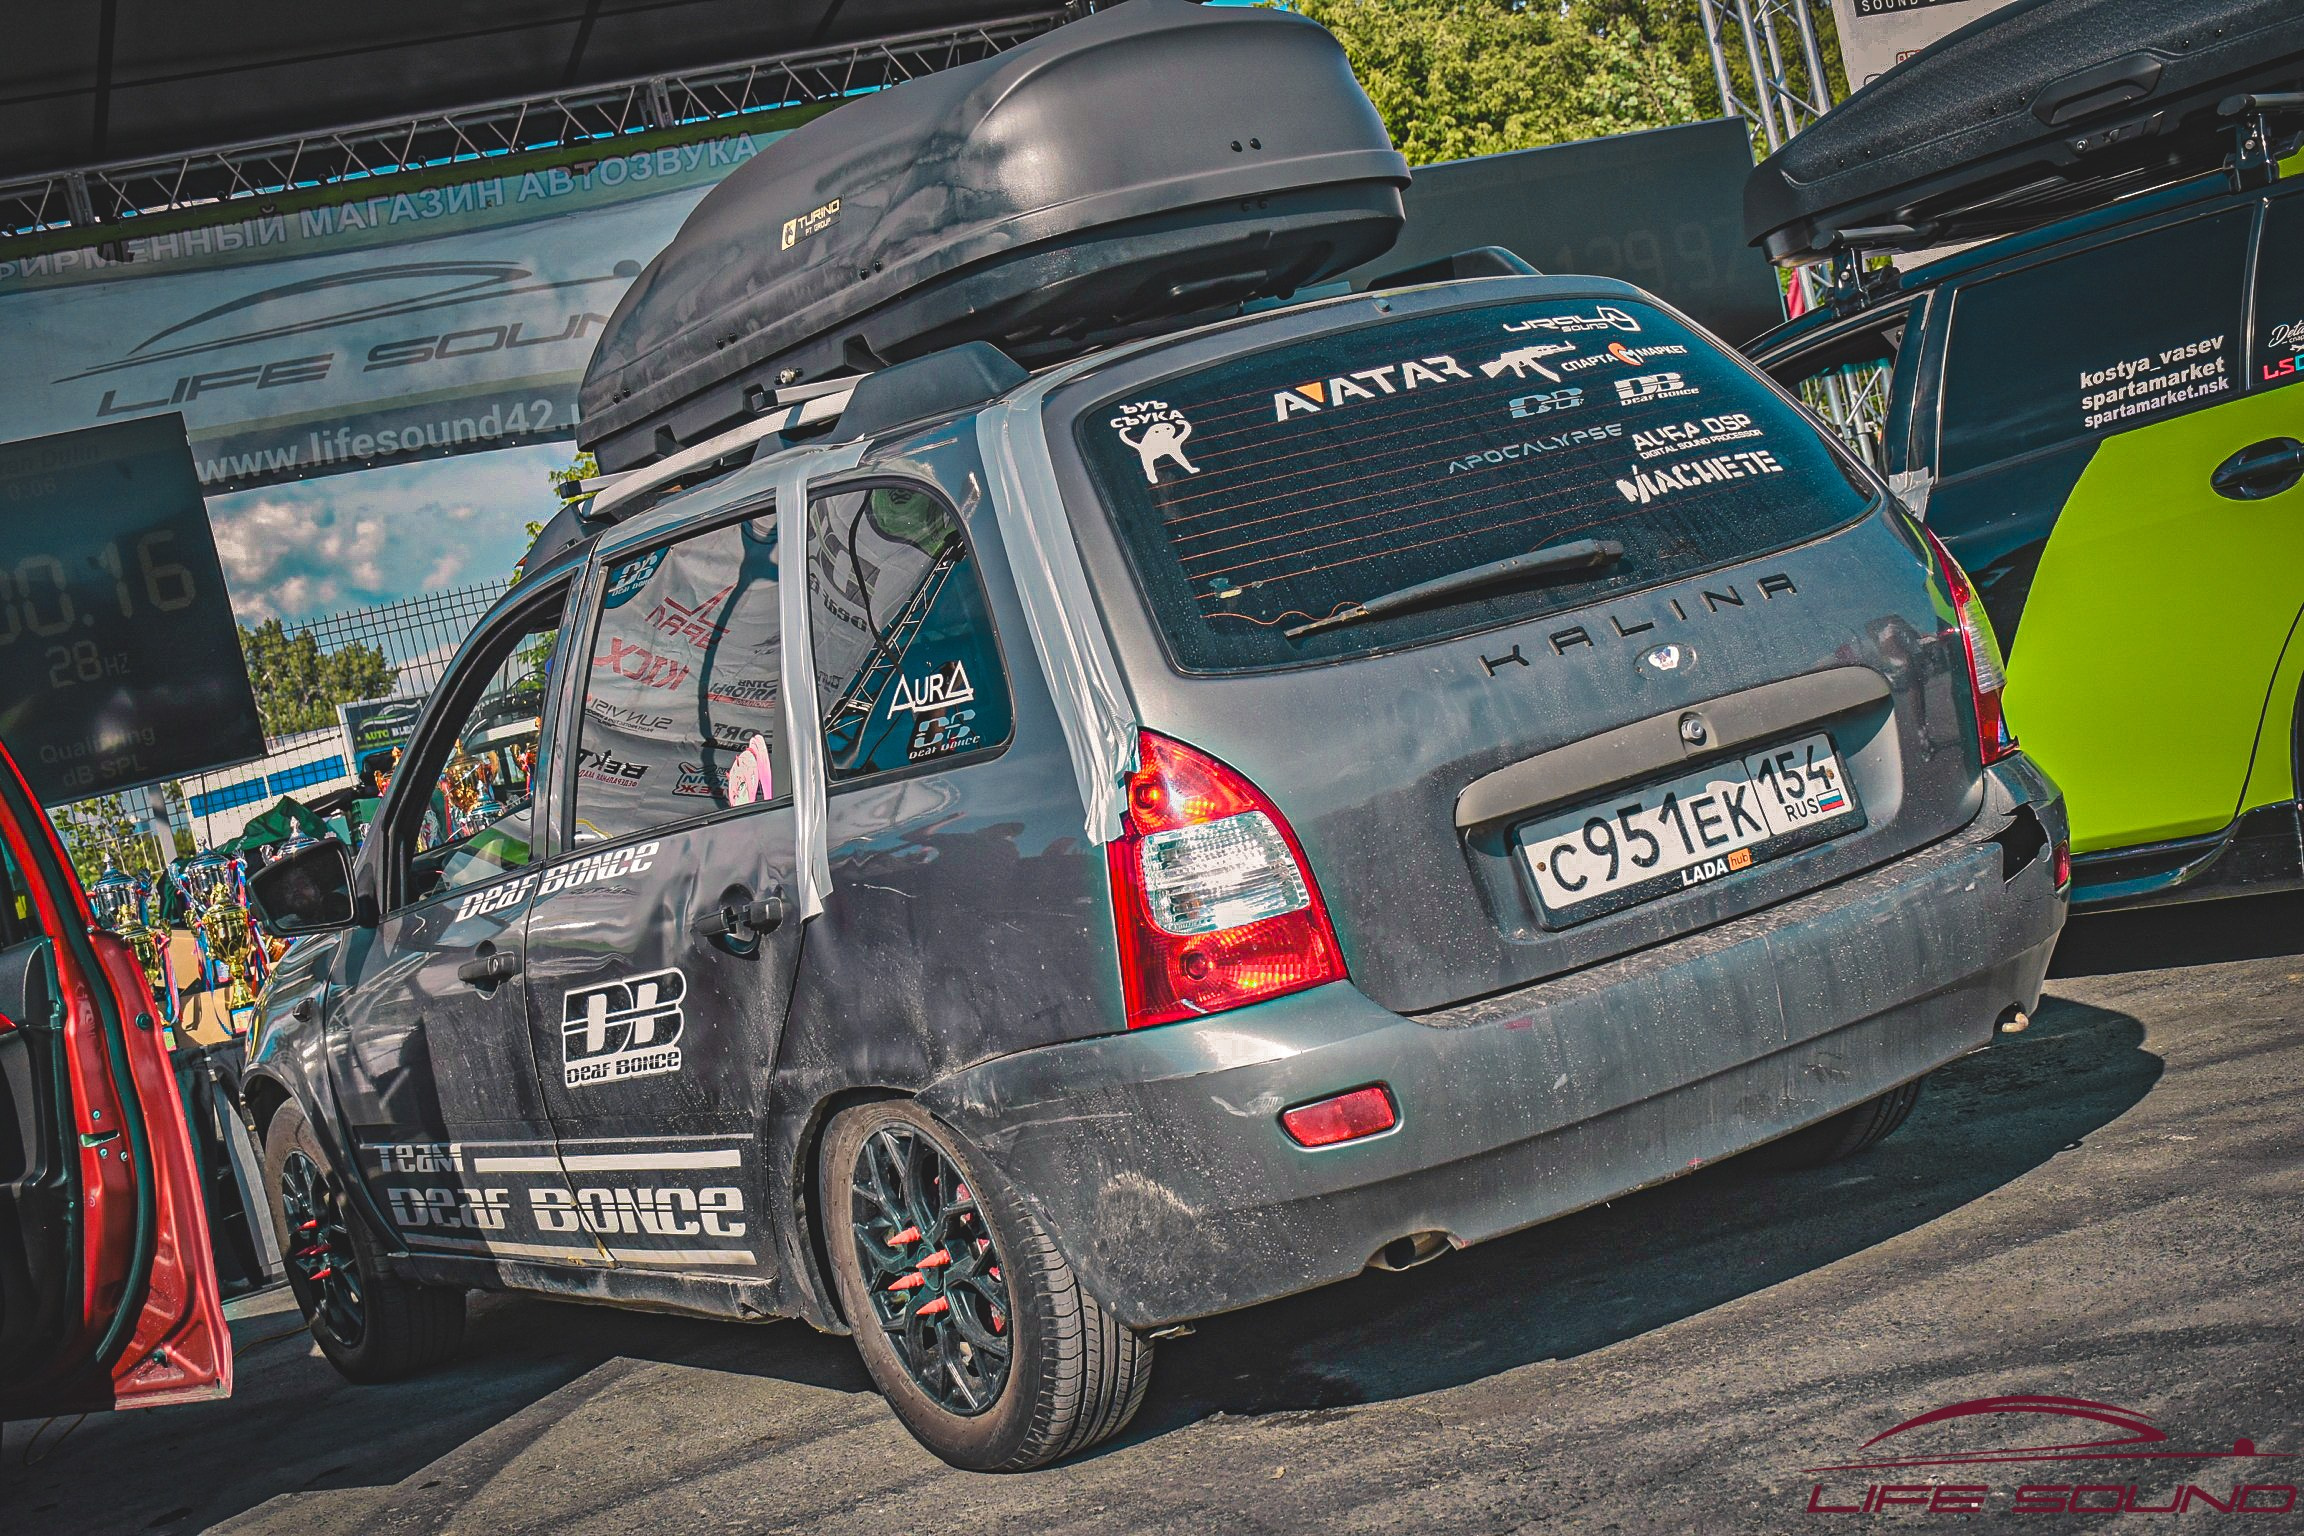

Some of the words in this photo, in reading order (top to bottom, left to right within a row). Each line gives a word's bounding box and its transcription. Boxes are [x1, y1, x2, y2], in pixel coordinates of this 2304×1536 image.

[301, 178, 505, 239] МАГАЗИН
[517, 132, 758, 202] АВТОЗВУКА
[798, 200, 840, 228] TURINO
[97, 352, 334, 417] LIFE
[1274, 354, 1473, 421] AVATAR
[2080, 335, 2224, 389] kostya_vasev
[2081, 356, 2226, 411] spartamarket
[1701, 413, 1751, 435] DSP
[2084, 376, 2230, 429] spartamarket.nsk
[1448, 423, 1622, 474] APOCALYPSE
[1640, 443, 1679, 460] DIGITAL
[1679, 437, 1711, 451] SOUND
[1711, 428, 1763, 444] PROCESSOR
[1615, 449, 1783, 503] MACHETE
[1478, 572, 1798, 677] KALINA
[40, 726, 156, 763] Qualiing
[1757, 745, 1832, 805] 154
[1784, 797, 1819, 823] RUS
[1680, 860, 1729, 886] LADA
[1730, 851, 1749, 869] hub
